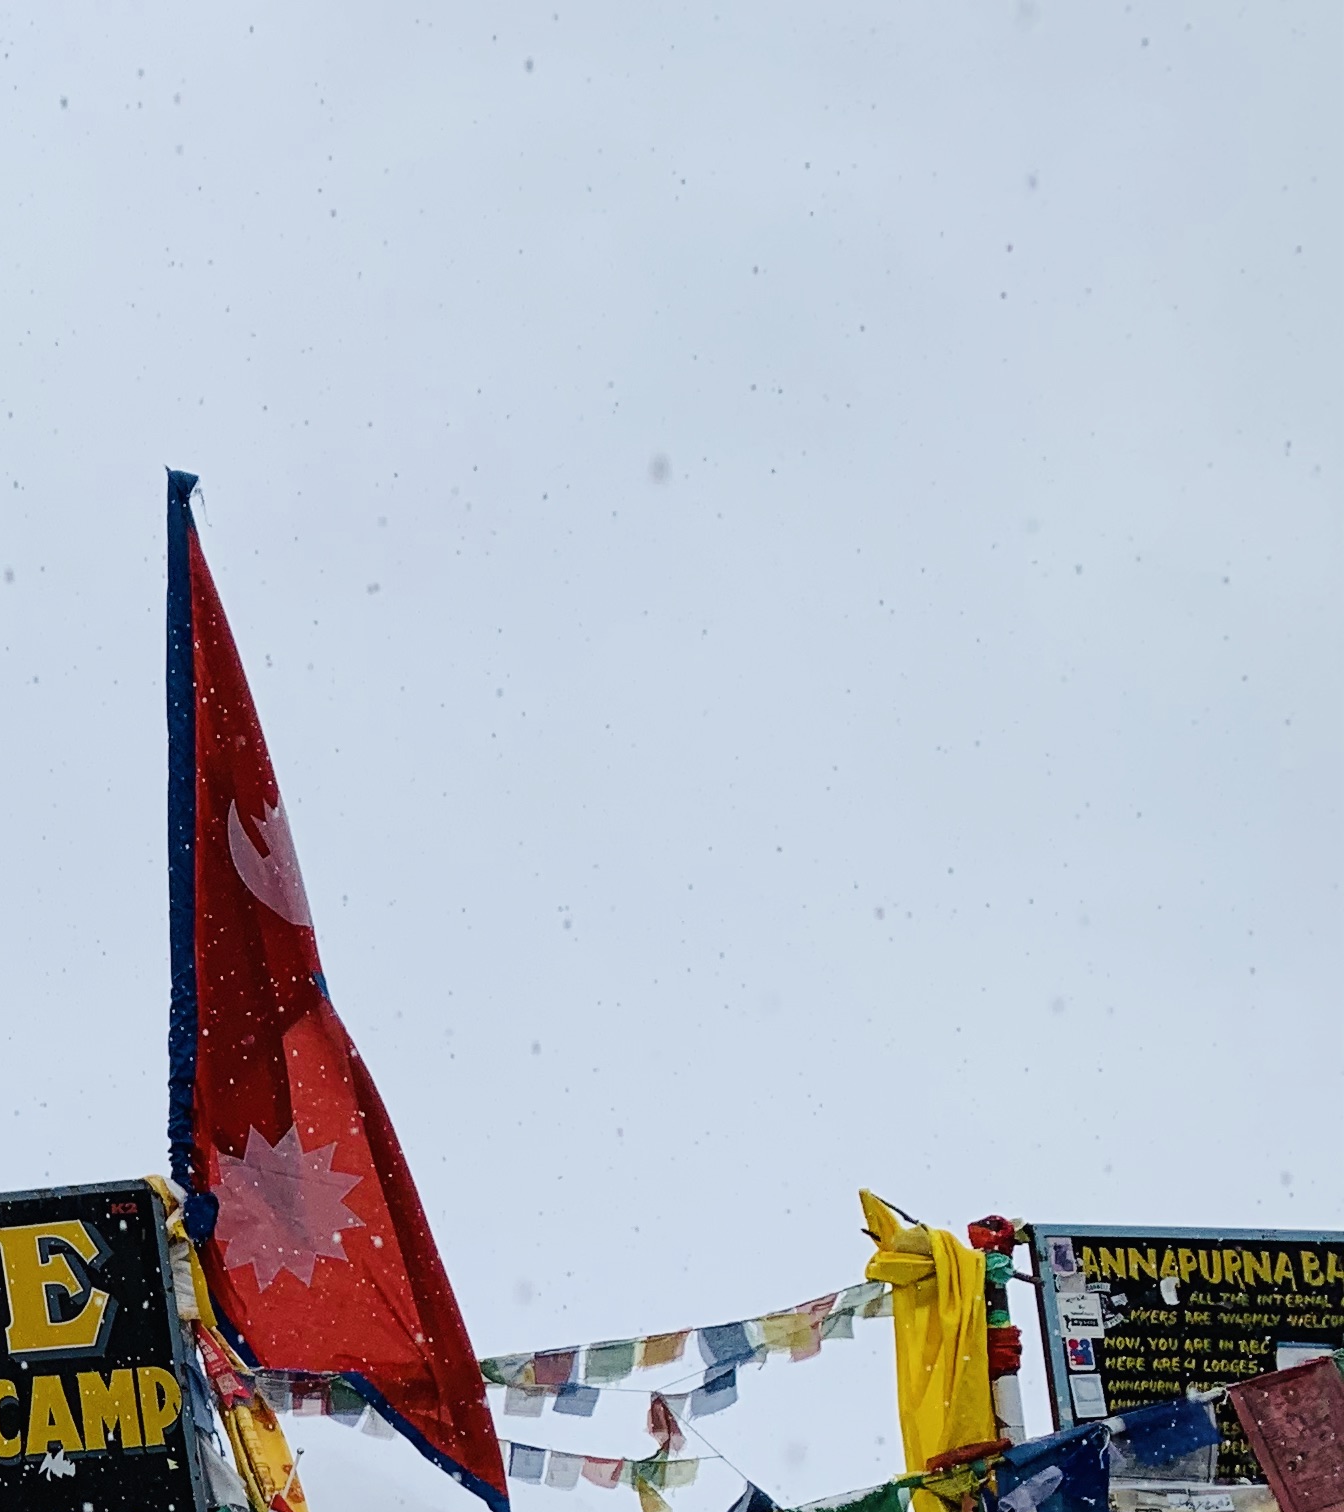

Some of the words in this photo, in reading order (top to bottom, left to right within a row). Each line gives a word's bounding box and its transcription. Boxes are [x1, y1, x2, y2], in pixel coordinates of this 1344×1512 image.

[1082, 1246, 1298, 1291] ANNAPURNA
[1147, 1337, 1178, 1351] YOU
[1184, 1338, 1211, 1353] ARE
